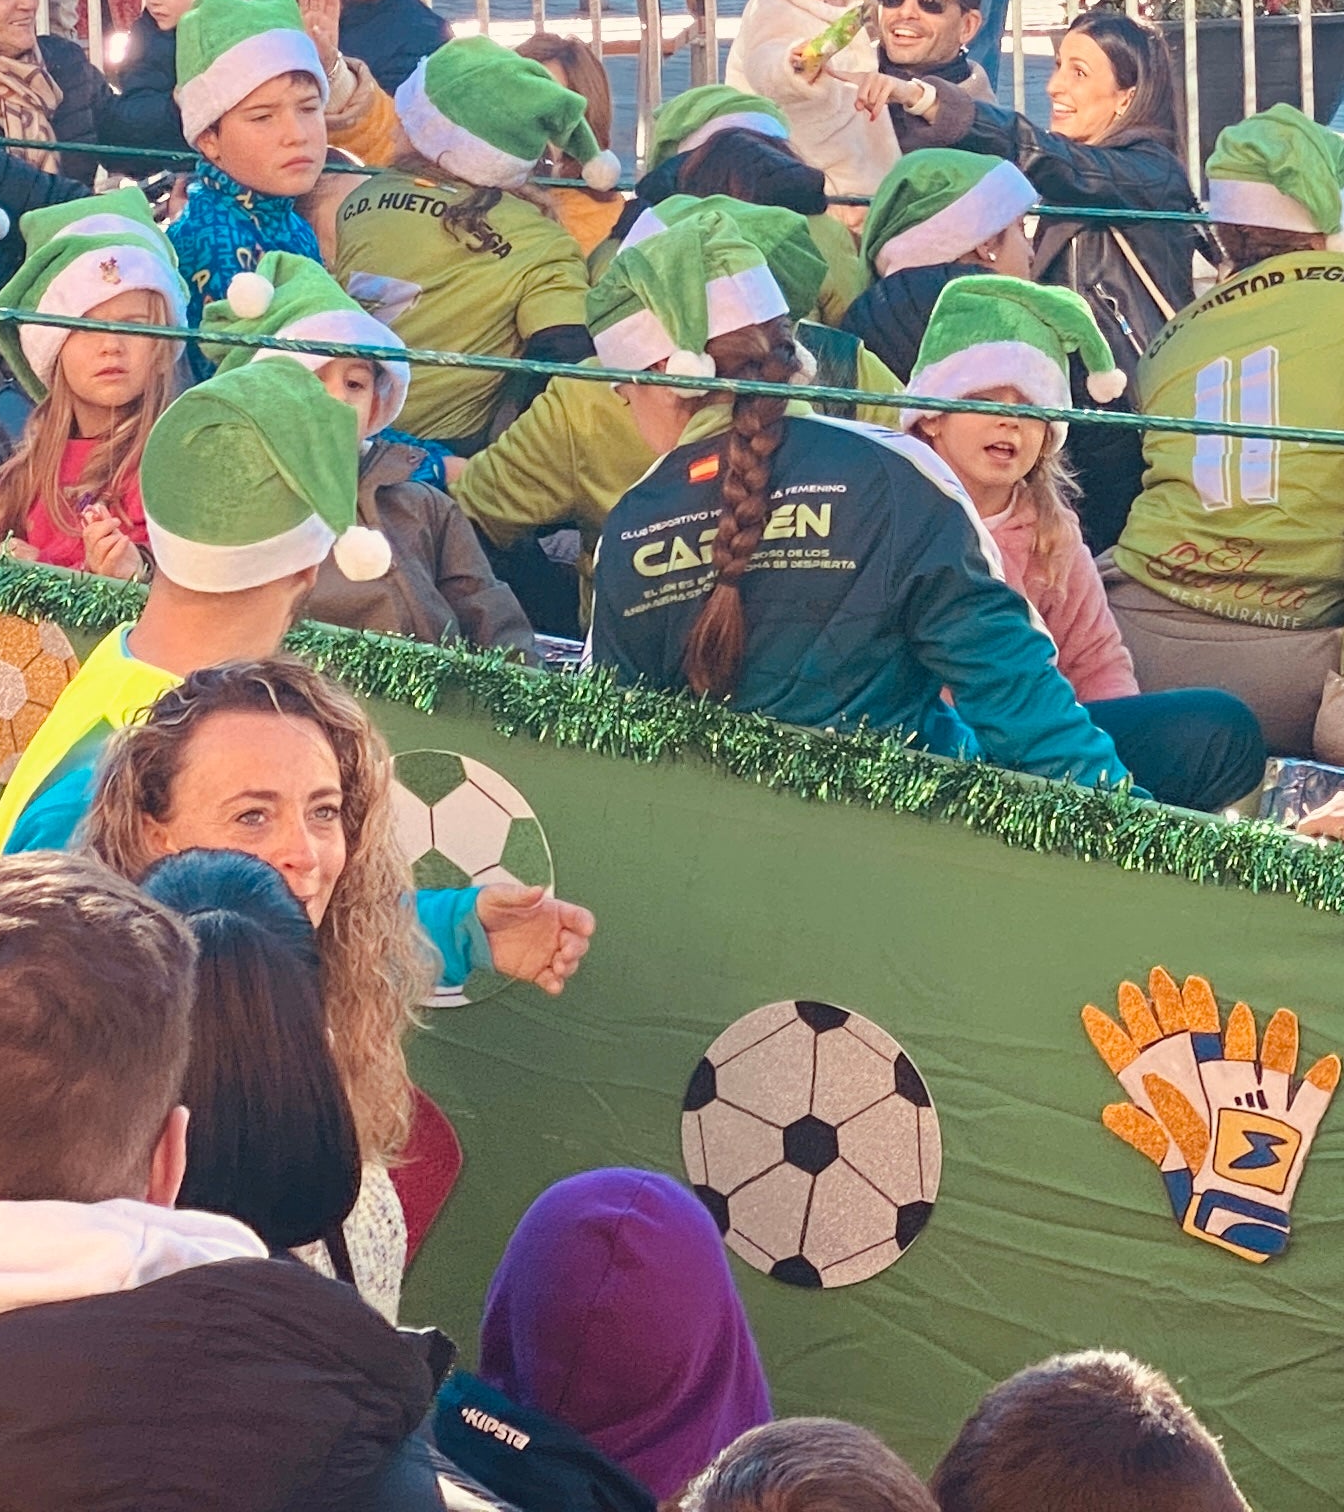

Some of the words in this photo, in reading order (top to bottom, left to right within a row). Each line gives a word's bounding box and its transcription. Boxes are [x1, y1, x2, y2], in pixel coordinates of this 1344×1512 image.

[343, 197, 372, 222] C.D.
[377, 192, 449, 218] HUETO
[620, 529, 649, 541] CLUB
[648, 511, 709, 533] DEPORTIVO
[785, 484, 848, 496] FEMENINO
[804, 549, 830, 557] LOS
